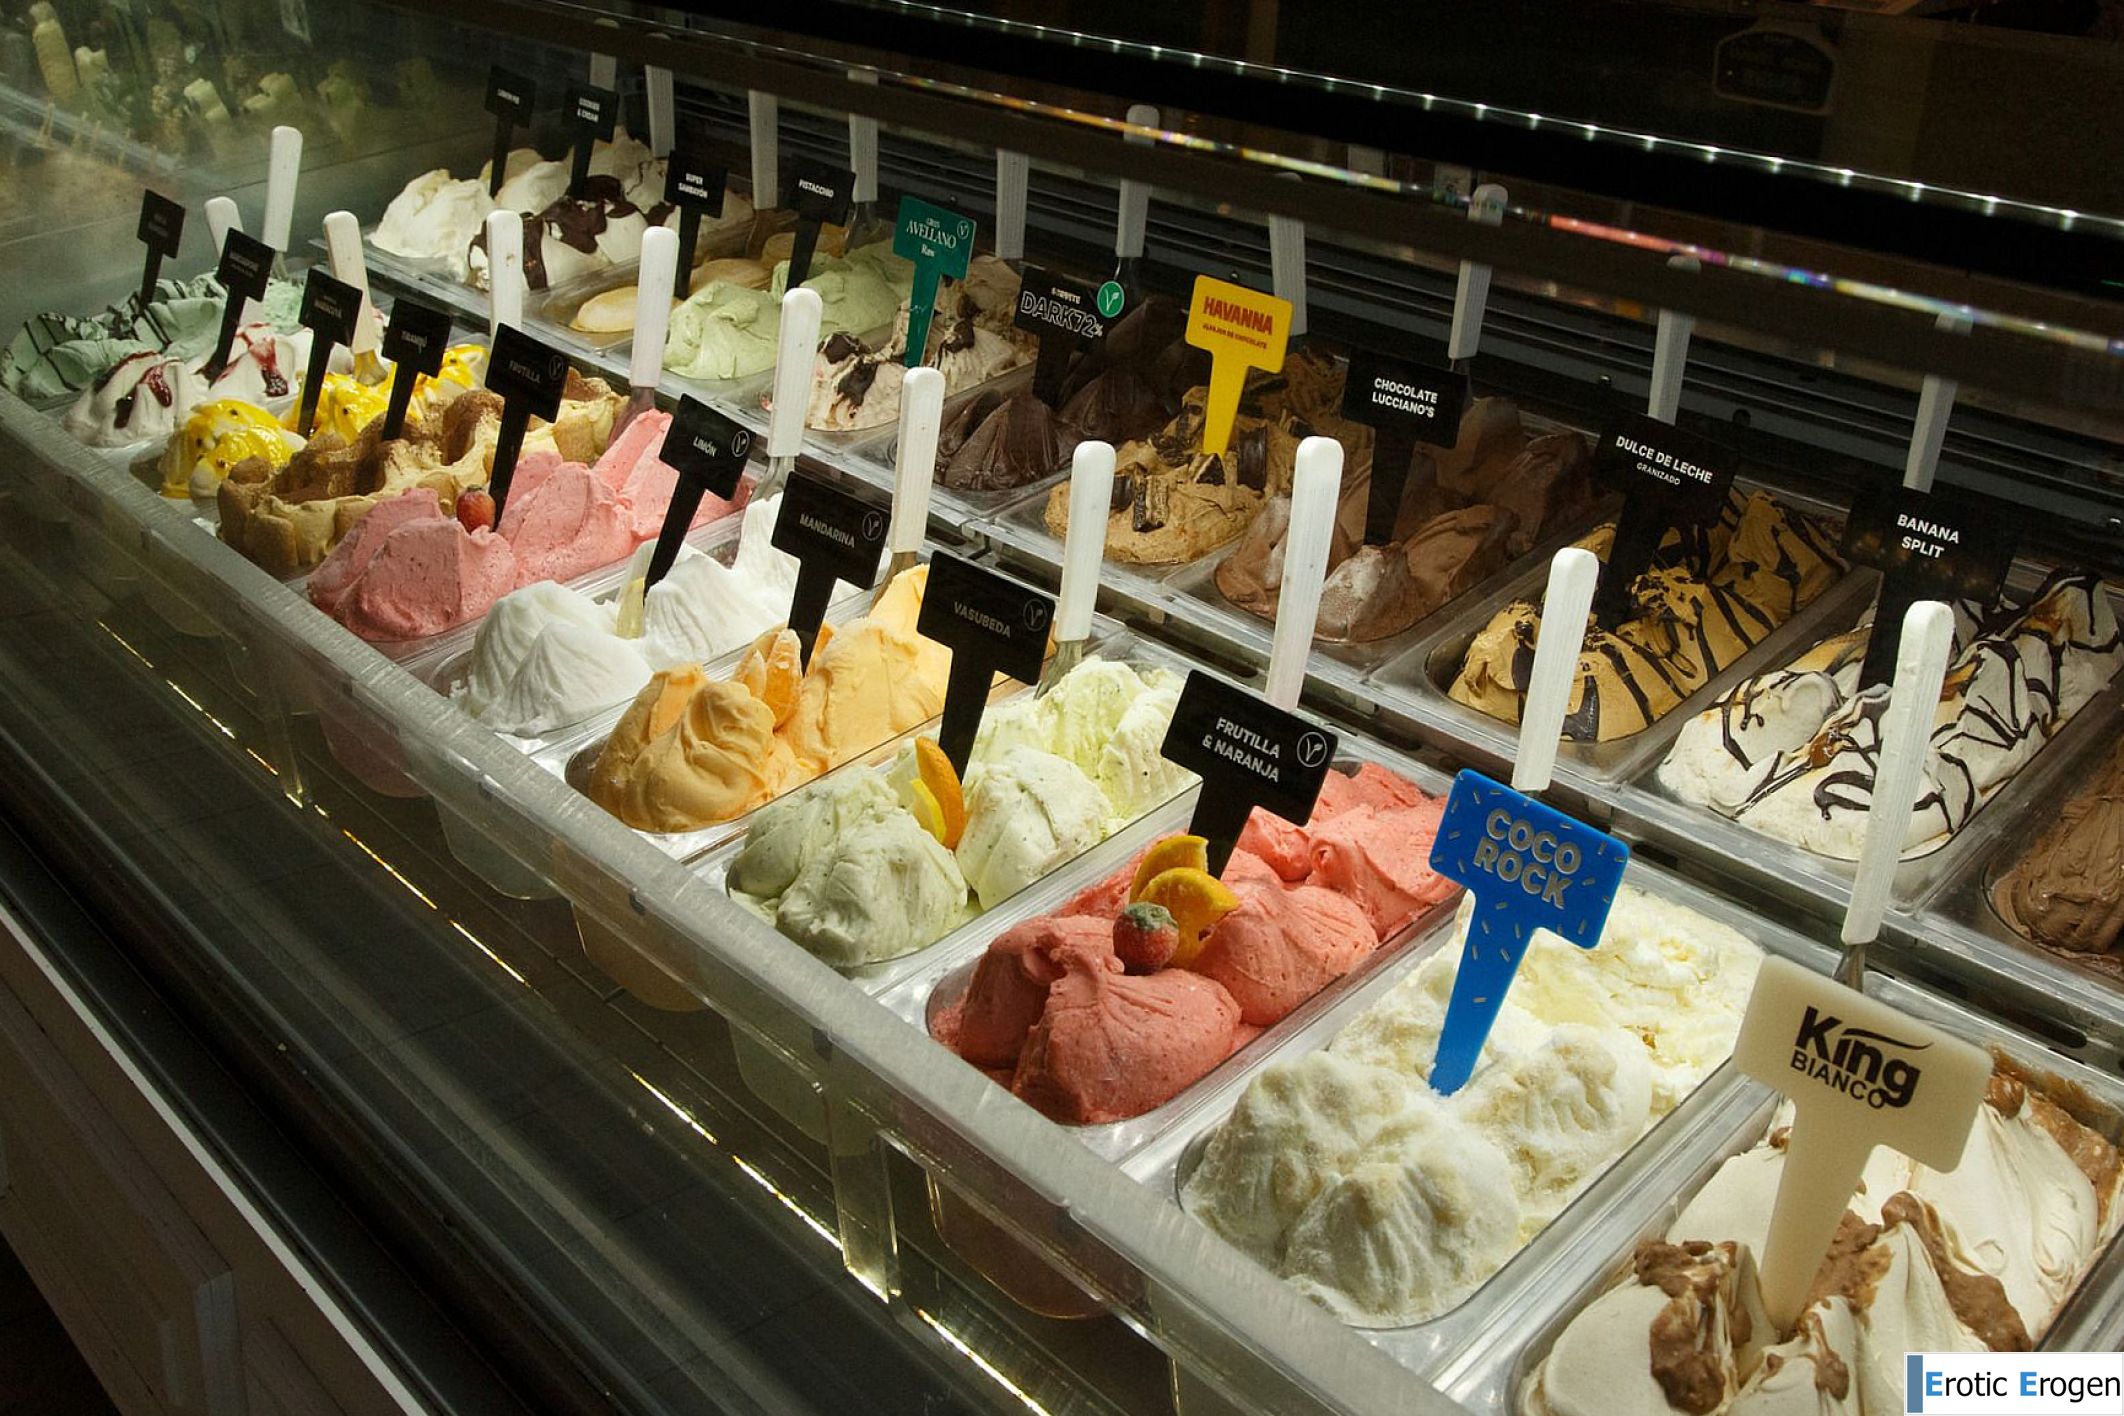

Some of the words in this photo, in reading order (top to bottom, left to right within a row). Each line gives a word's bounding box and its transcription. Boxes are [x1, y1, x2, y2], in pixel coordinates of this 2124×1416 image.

[906, 219, 957, 249] AVELLANO
[1203, 296, 1273, 335] HAVANNA
[1372, 391, 1435, 418] LUCCIANO'S
[1374, 377, 1438, 404] CHOCOLATE
[693, 435, 718, 457] LIMÓN
[1615, 435, 1655, 460] DULCE
[1655, 451, 1672, 467] DE
[1672, 458, 1714, 484] LECHE
[1636, 462, 1681, 486] GRANIZADO
[800, 512, 856, 549] MANDARINA
[1897, 513, 1960, 545] BANANA
[1901, 536, 1945, 559] SPLIT
[953, 601, 1011, 639] VASUBEDA
[1215, 716, 1281, 759] FRUTILLA
[1202, 734, 1212, 749] &
[1214, 739, 1280, 783] NARANJA
[1486, 808, 1582, 875] COCO
[1472, 836, 1573, 910] ROCK
[1794, 1005, 1922, 1108] King
[1790, 1050, 1887, 1110] BIANCO
